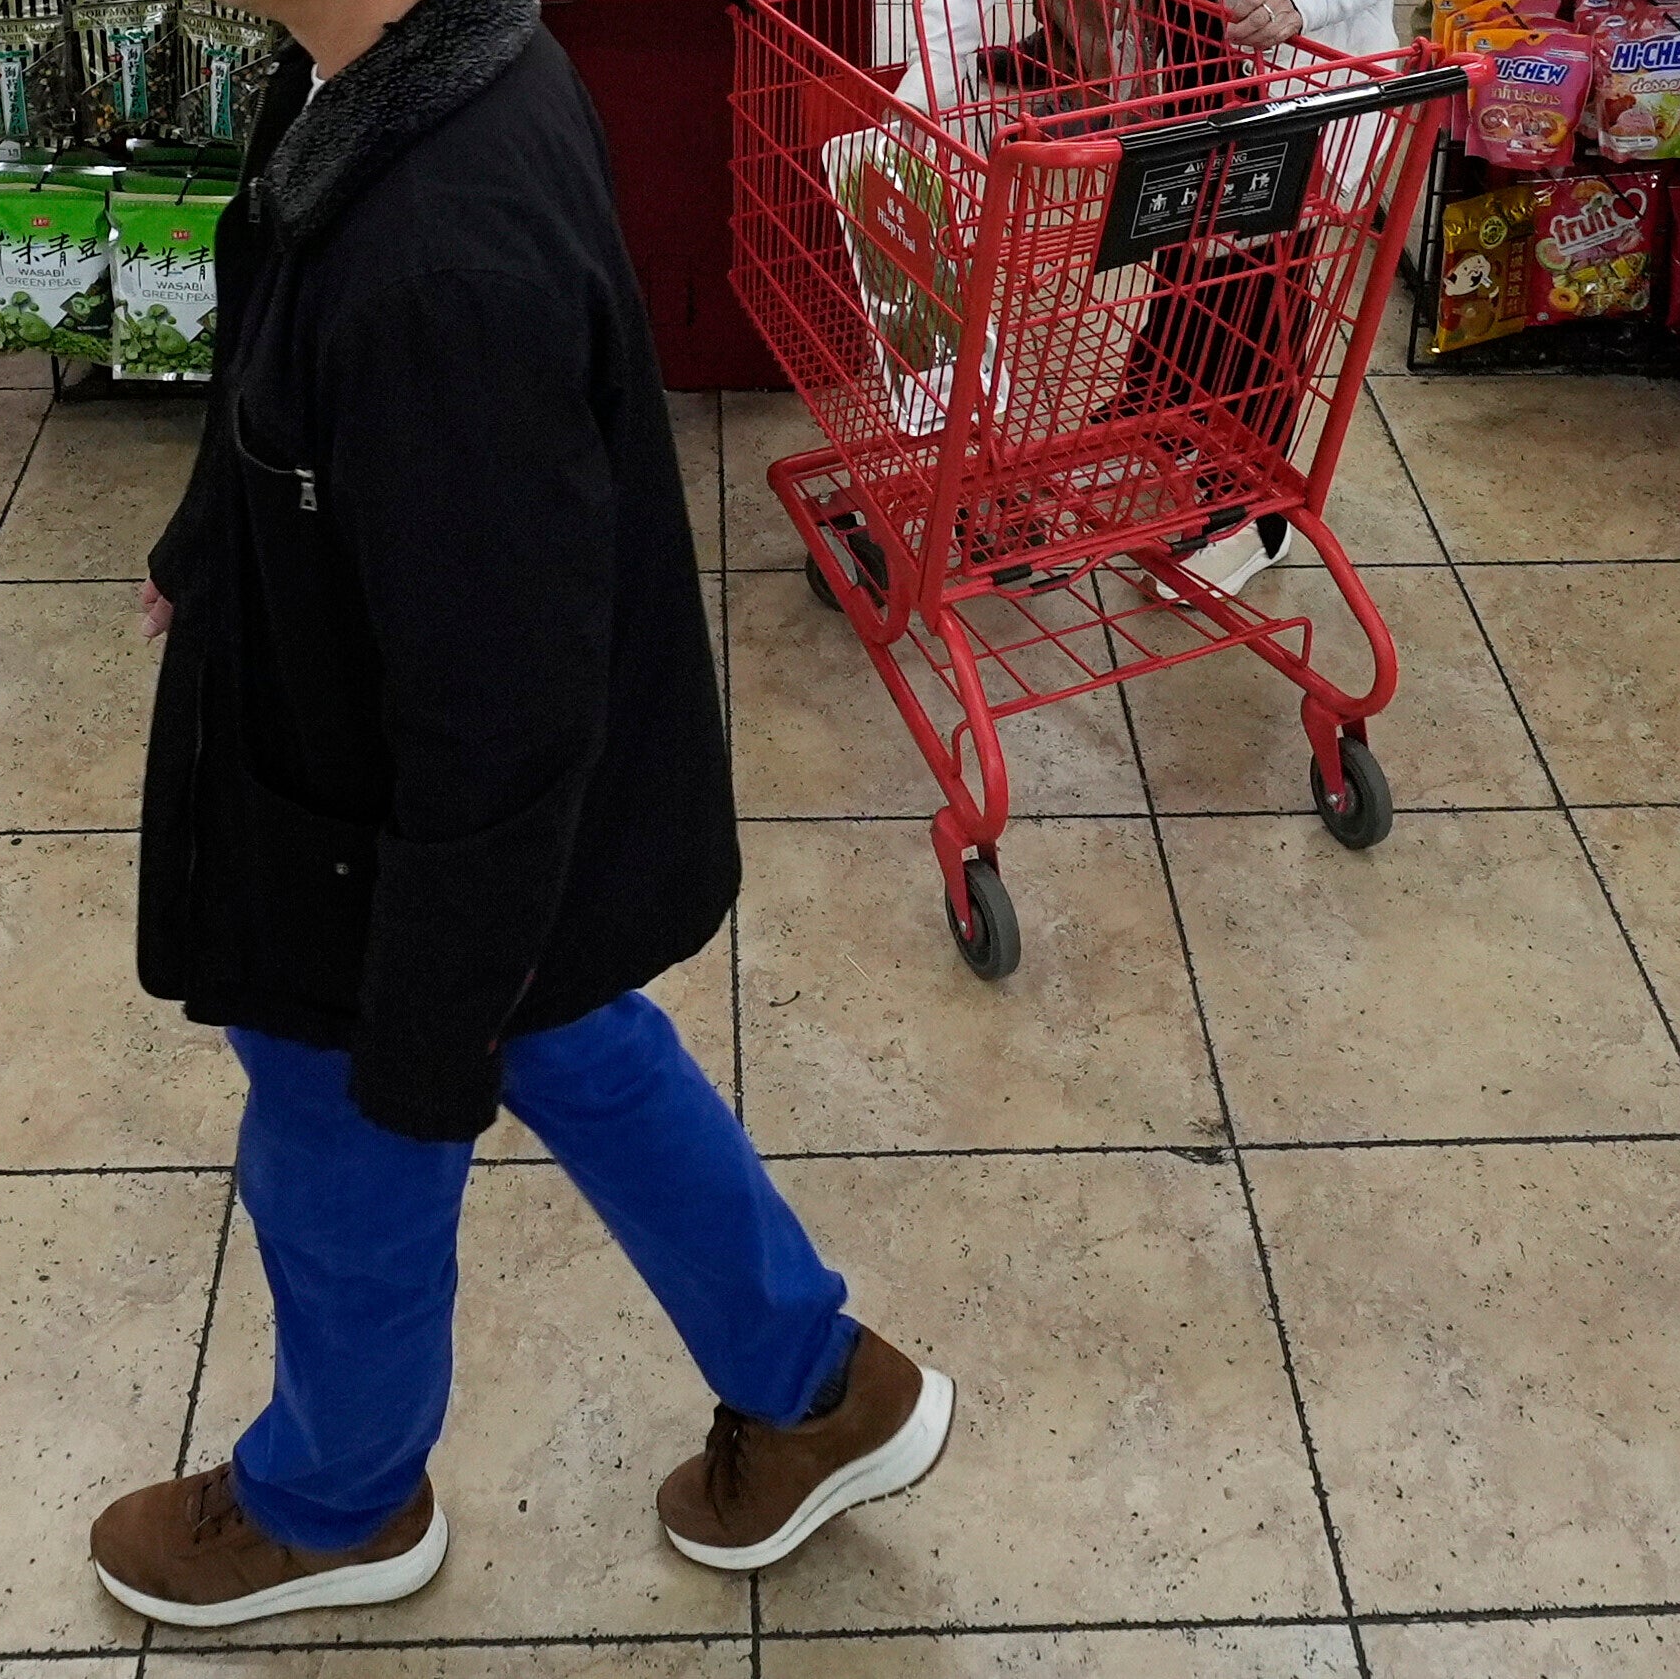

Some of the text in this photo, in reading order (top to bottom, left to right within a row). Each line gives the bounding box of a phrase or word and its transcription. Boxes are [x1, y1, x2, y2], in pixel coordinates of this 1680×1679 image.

[18, 268, 65, 277] WASABI
[5, 277, 82, 287] GREEN PEAS
[155, 281, 203, 292] WASABI
[142, 290, 184, 300] GREEN
